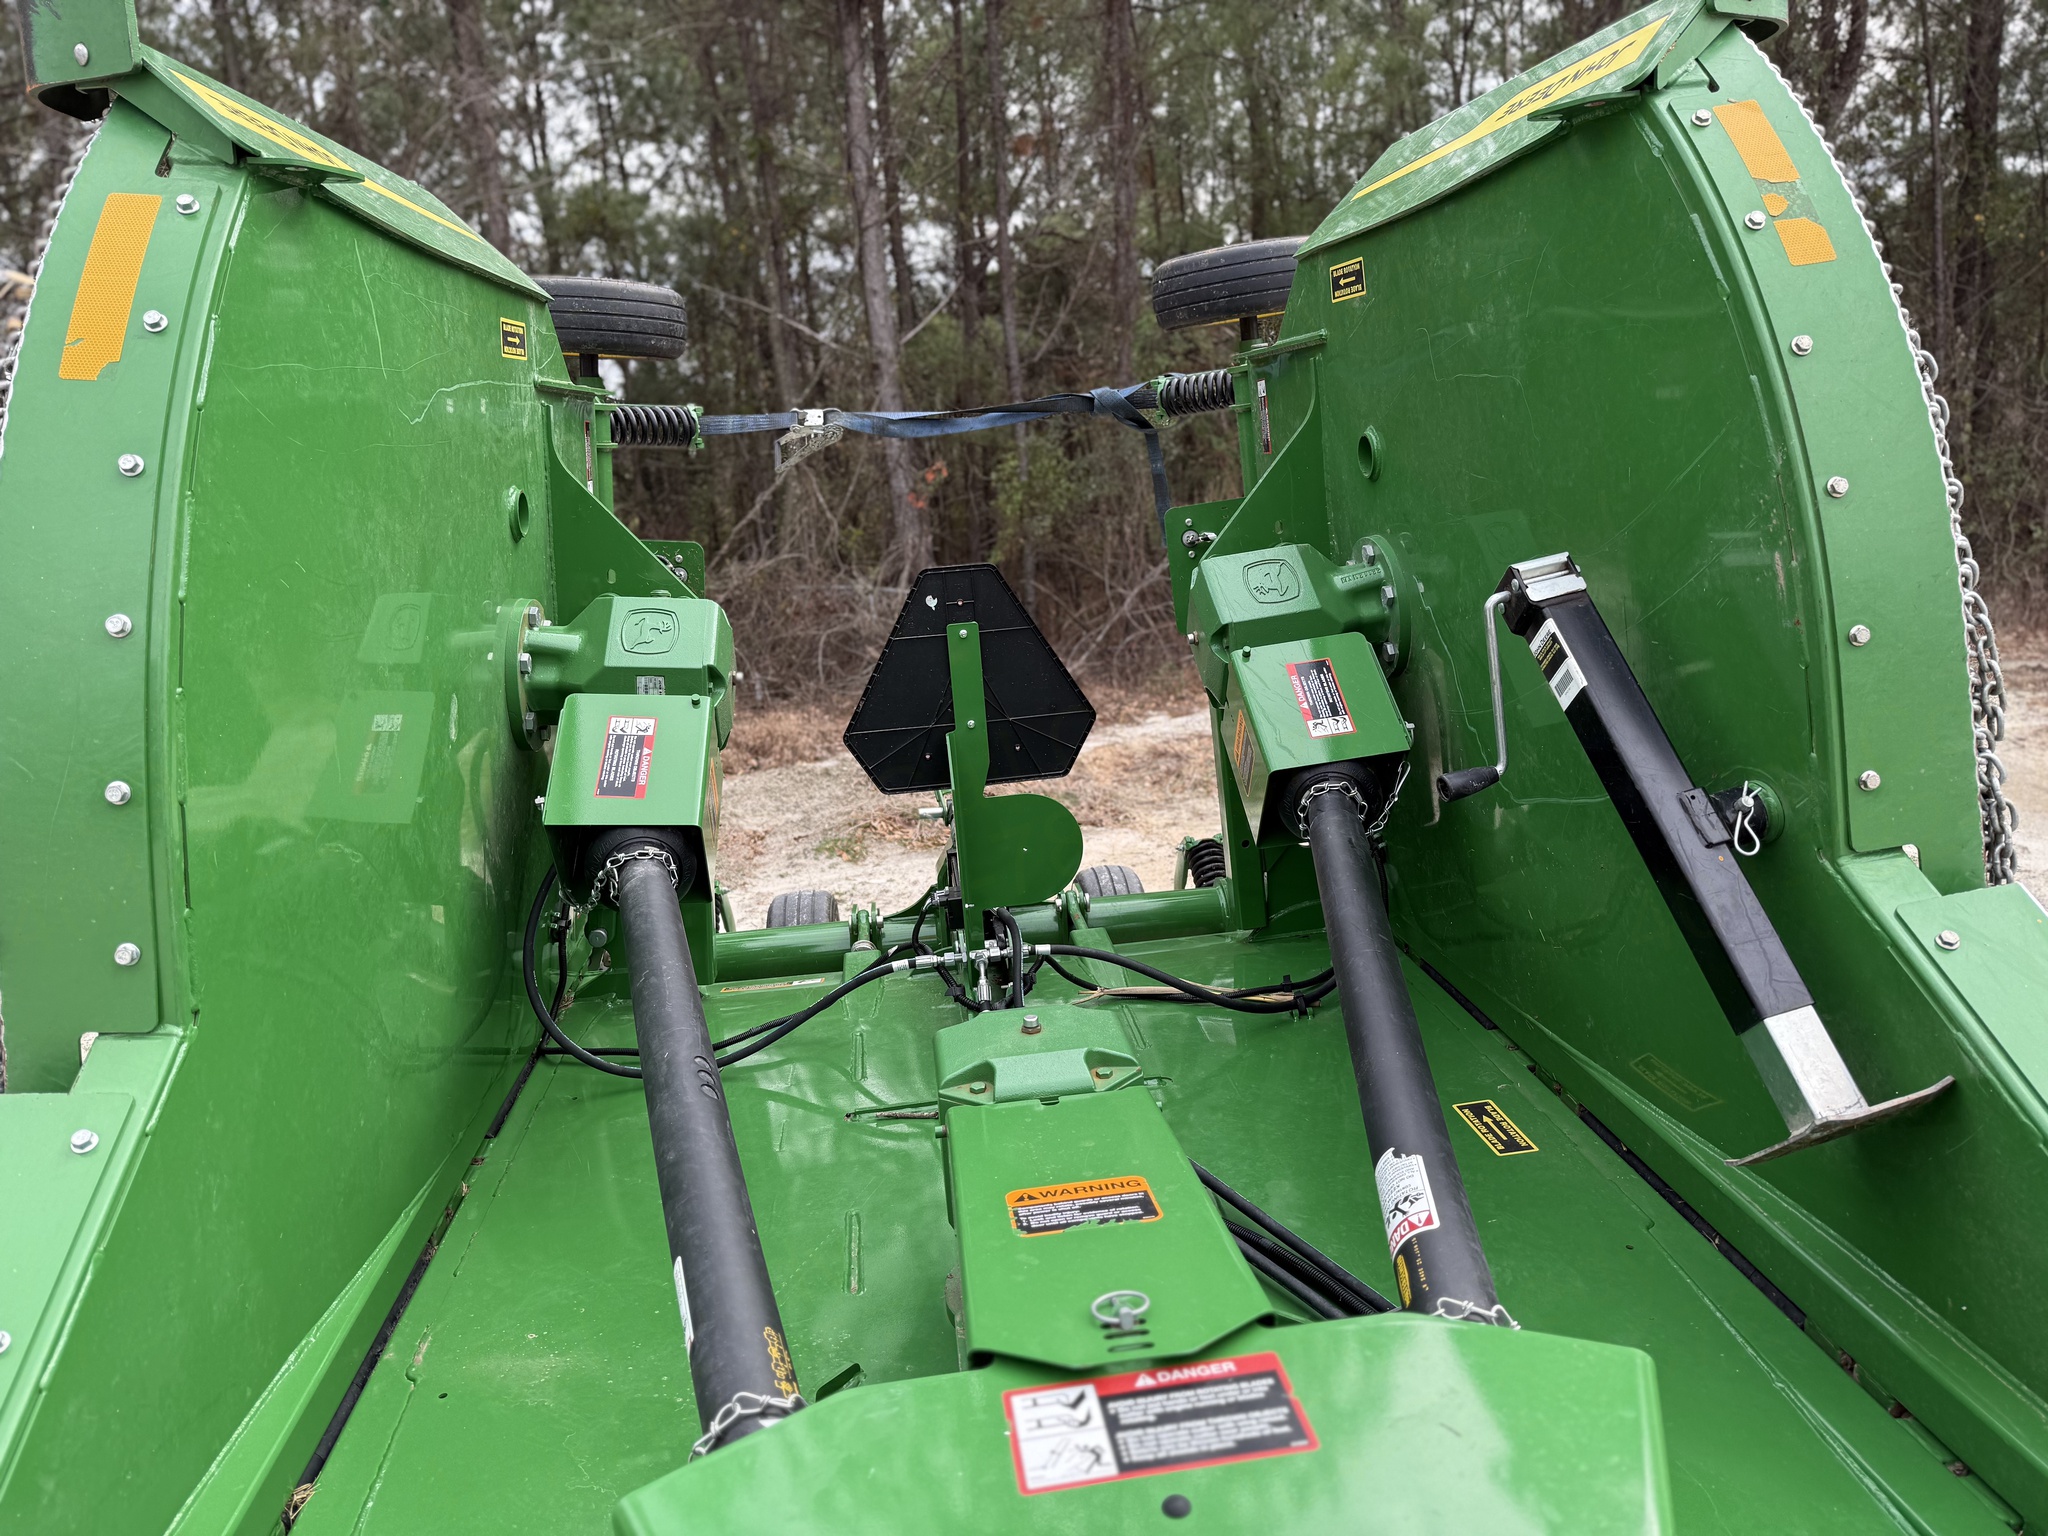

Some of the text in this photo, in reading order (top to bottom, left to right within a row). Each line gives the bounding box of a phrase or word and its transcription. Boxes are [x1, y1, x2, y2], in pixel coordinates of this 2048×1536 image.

[1495, 74, 1571, 122] DEERE
[1291, 674, 1306, 701] DANGER
[638, 755, 650, 785] DANGER
[1462, 1108, 1505, 1150] BLADE ROTATION
[1484, 1105, 1529, 1148] BLADE ROTATION
[1039, 1179, 1142, 1198] WARNING
[1156, 1361, 1237, 1383] DANGER
